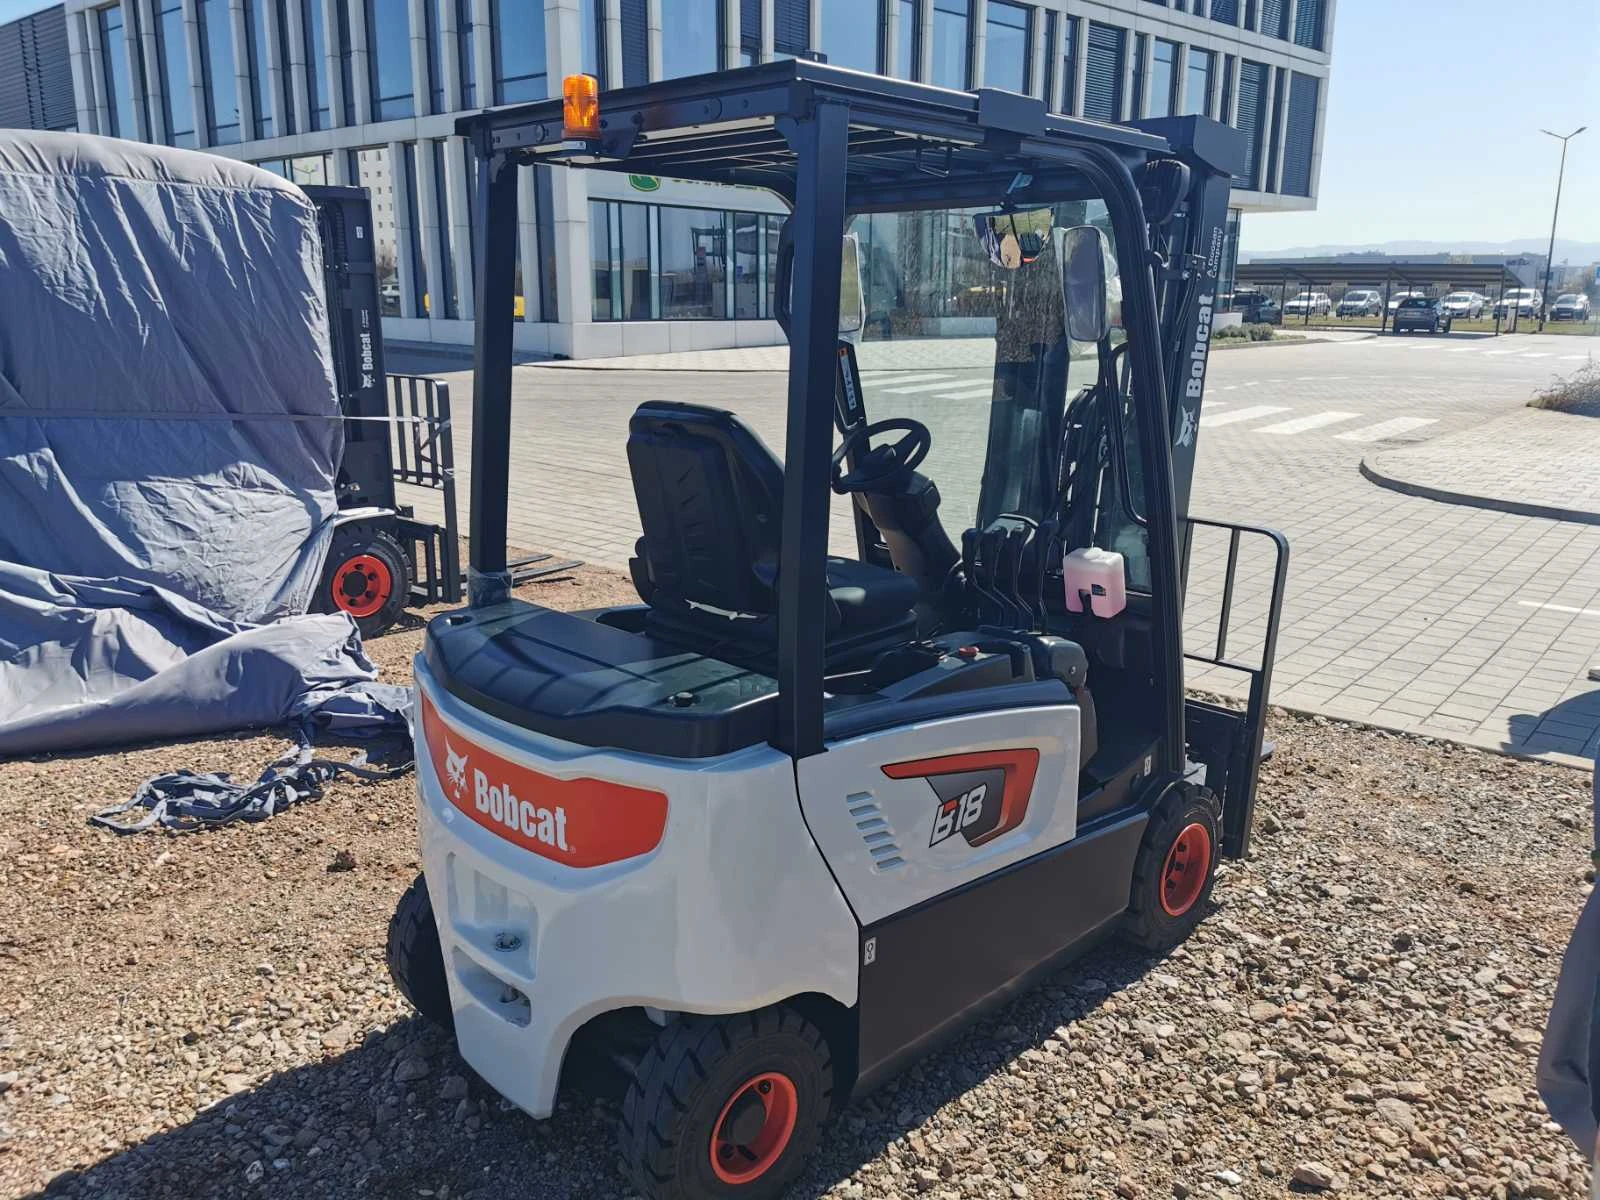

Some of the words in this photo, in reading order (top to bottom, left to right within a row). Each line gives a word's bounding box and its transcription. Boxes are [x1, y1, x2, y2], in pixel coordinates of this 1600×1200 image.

[1208, 226, 1218, 266] Doosan
[1212, 227, 1223, 278] Company
[360, 333, 373, 370] Bobcat
[1186, 294, 1214, 397] Bobcat
[474, 767, 568, 852] Bobcat
